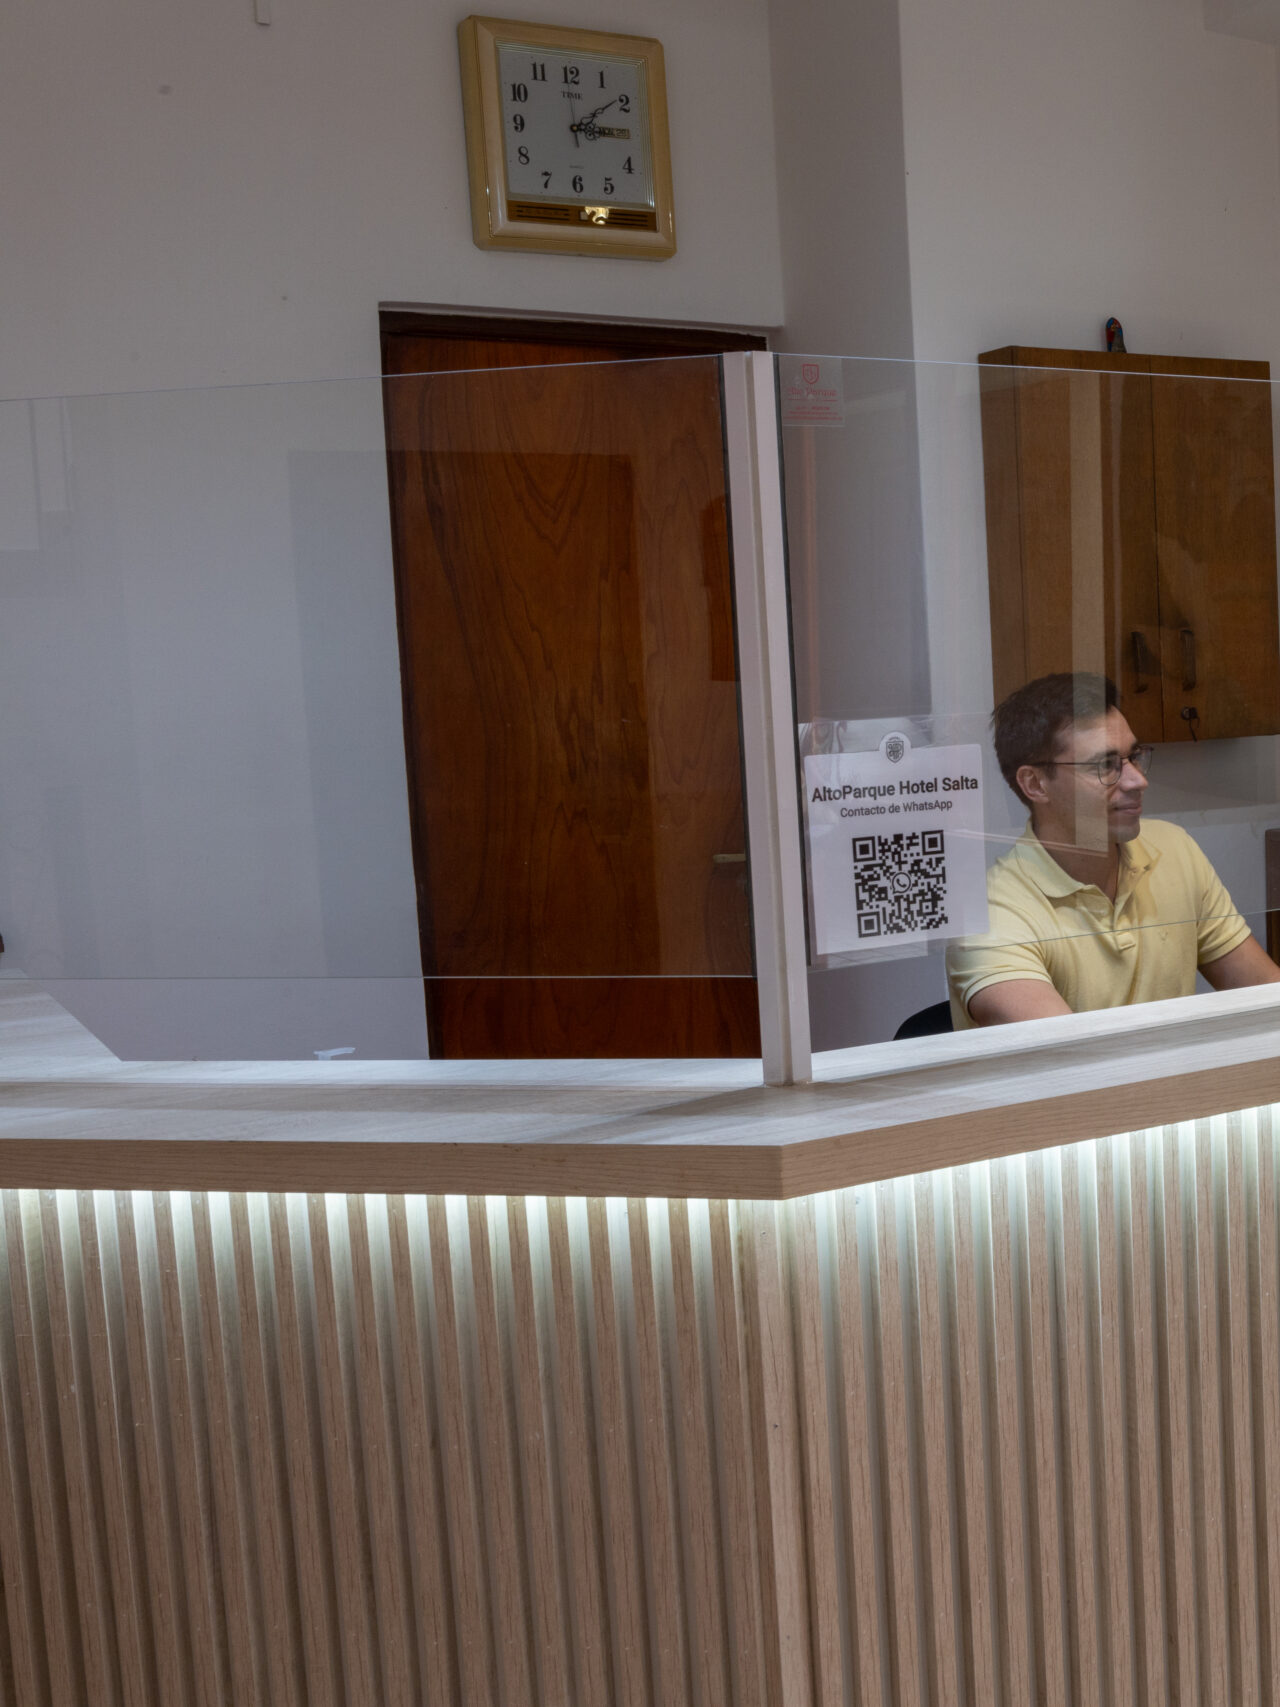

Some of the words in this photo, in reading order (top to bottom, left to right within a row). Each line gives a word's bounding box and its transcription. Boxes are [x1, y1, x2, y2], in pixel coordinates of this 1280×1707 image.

[531, 61, 548, 82] 11
[561, 65, 580, 85] 12
[598, 70, 607, 89] 1
[511, 83, 528, 103] 10
[561, 90, 583, 100] TIME
[618, 94, 631, 113] 2
[513, 114, 525, 133] 9
[518, 145, 530, 165] 8
[622, 156, 635, 174] 4
[541, 171, 552, 189] 7
[572, 175, 584, 193] 6
[603, 177, 615, 195] 5
[811, 784, 896, 803] AltoParque
[899, 777, 938, 796] Hotel
[942, 774, 979, 792] Salta
[840, 804, 886, 818] Contacto
[888, 803, 901, 814] de
[903, 799, 953, 813] WhatsApp
